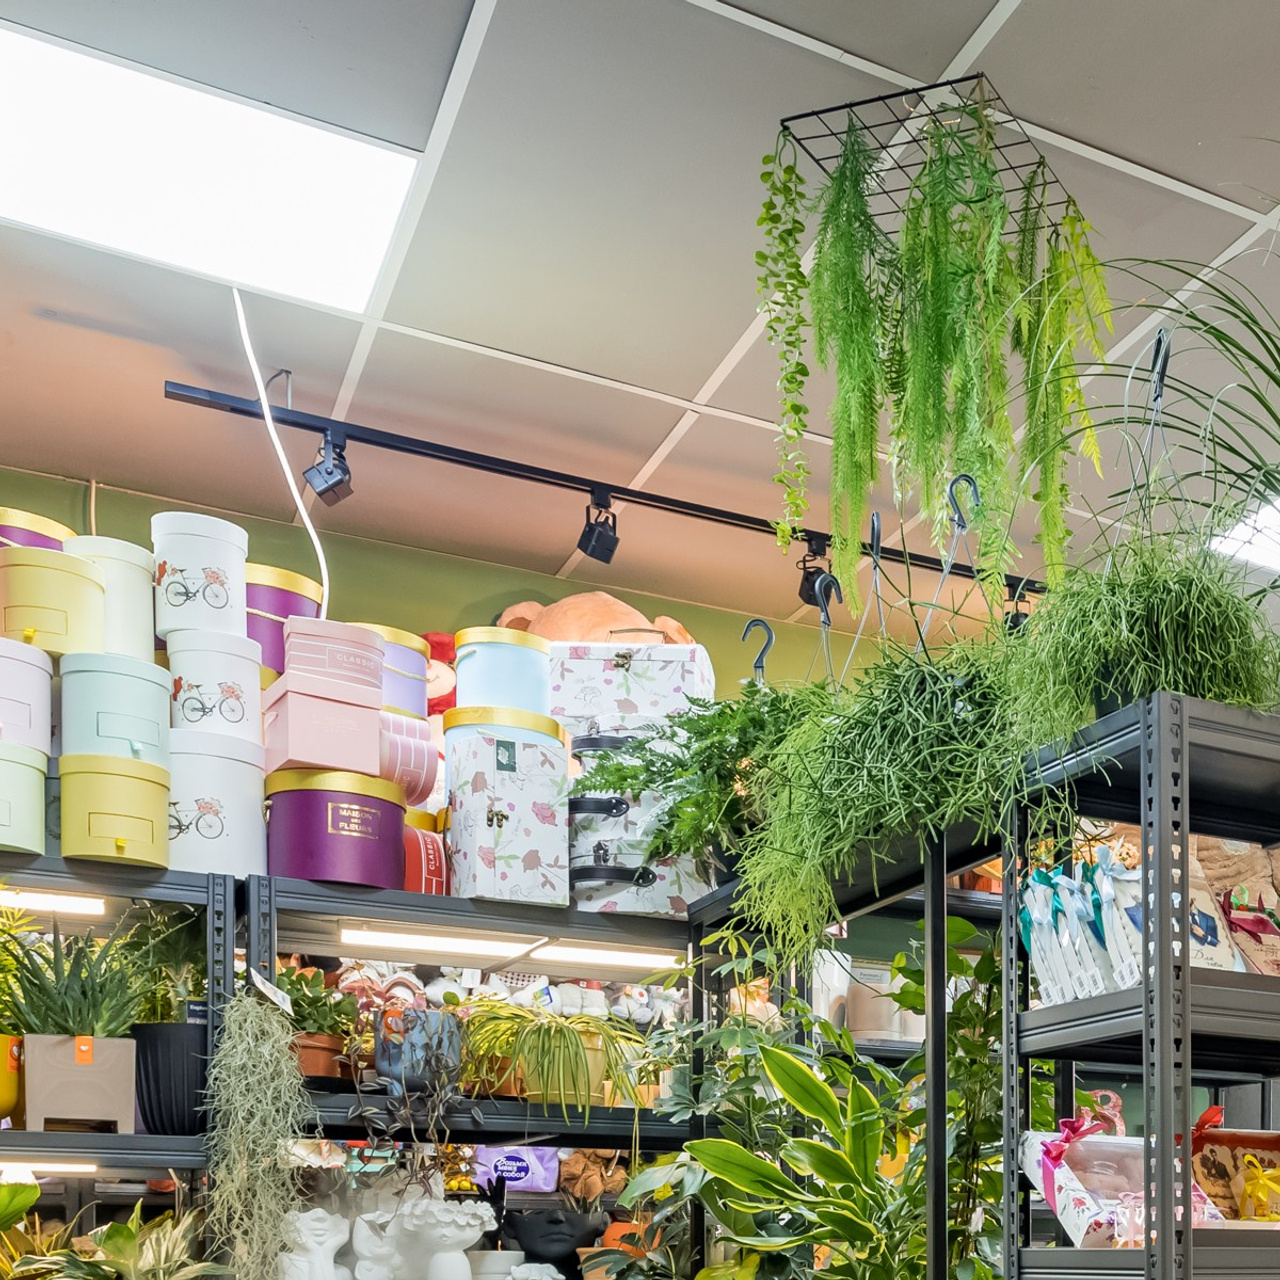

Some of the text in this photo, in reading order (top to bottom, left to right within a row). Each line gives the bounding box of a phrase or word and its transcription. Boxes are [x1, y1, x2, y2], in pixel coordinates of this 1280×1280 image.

[335, 653, 375, 669] CLASSIC
[339, 809, 373, 820] MAISON
[339, 822, 373, 833] FLEURS
[425, 836, 436, 871] CLASSIC
